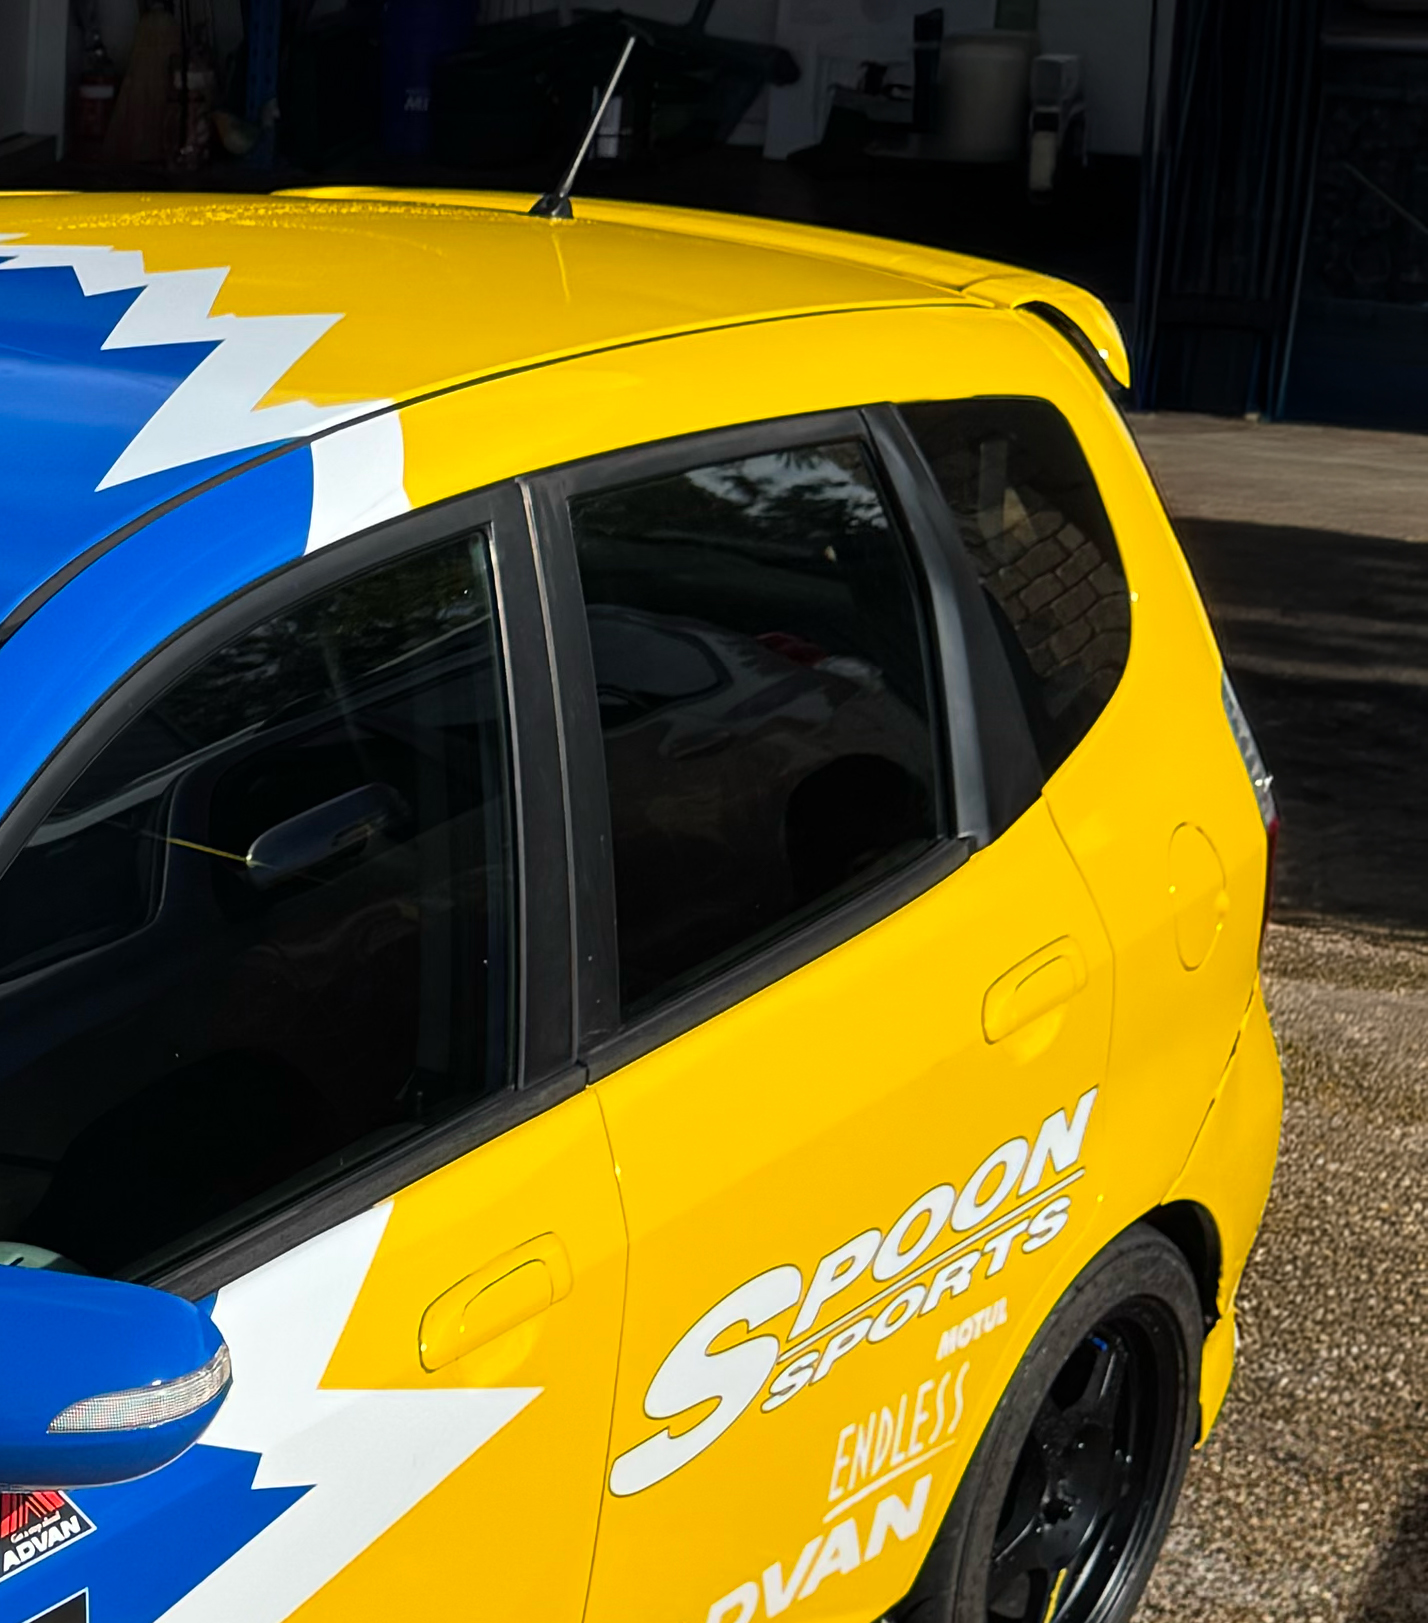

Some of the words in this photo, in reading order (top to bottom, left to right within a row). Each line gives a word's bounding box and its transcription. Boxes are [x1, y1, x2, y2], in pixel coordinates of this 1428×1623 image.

[608, 1084, 1099, 1498] SPOON
[759, 1195, 1072, 1414] SPORTS
[935, 1296, 1008, 1362] MOTUL
[828, 1360, 971, 1503] ENDLESS
[3, 1515, 81, 1573] ADVAN
